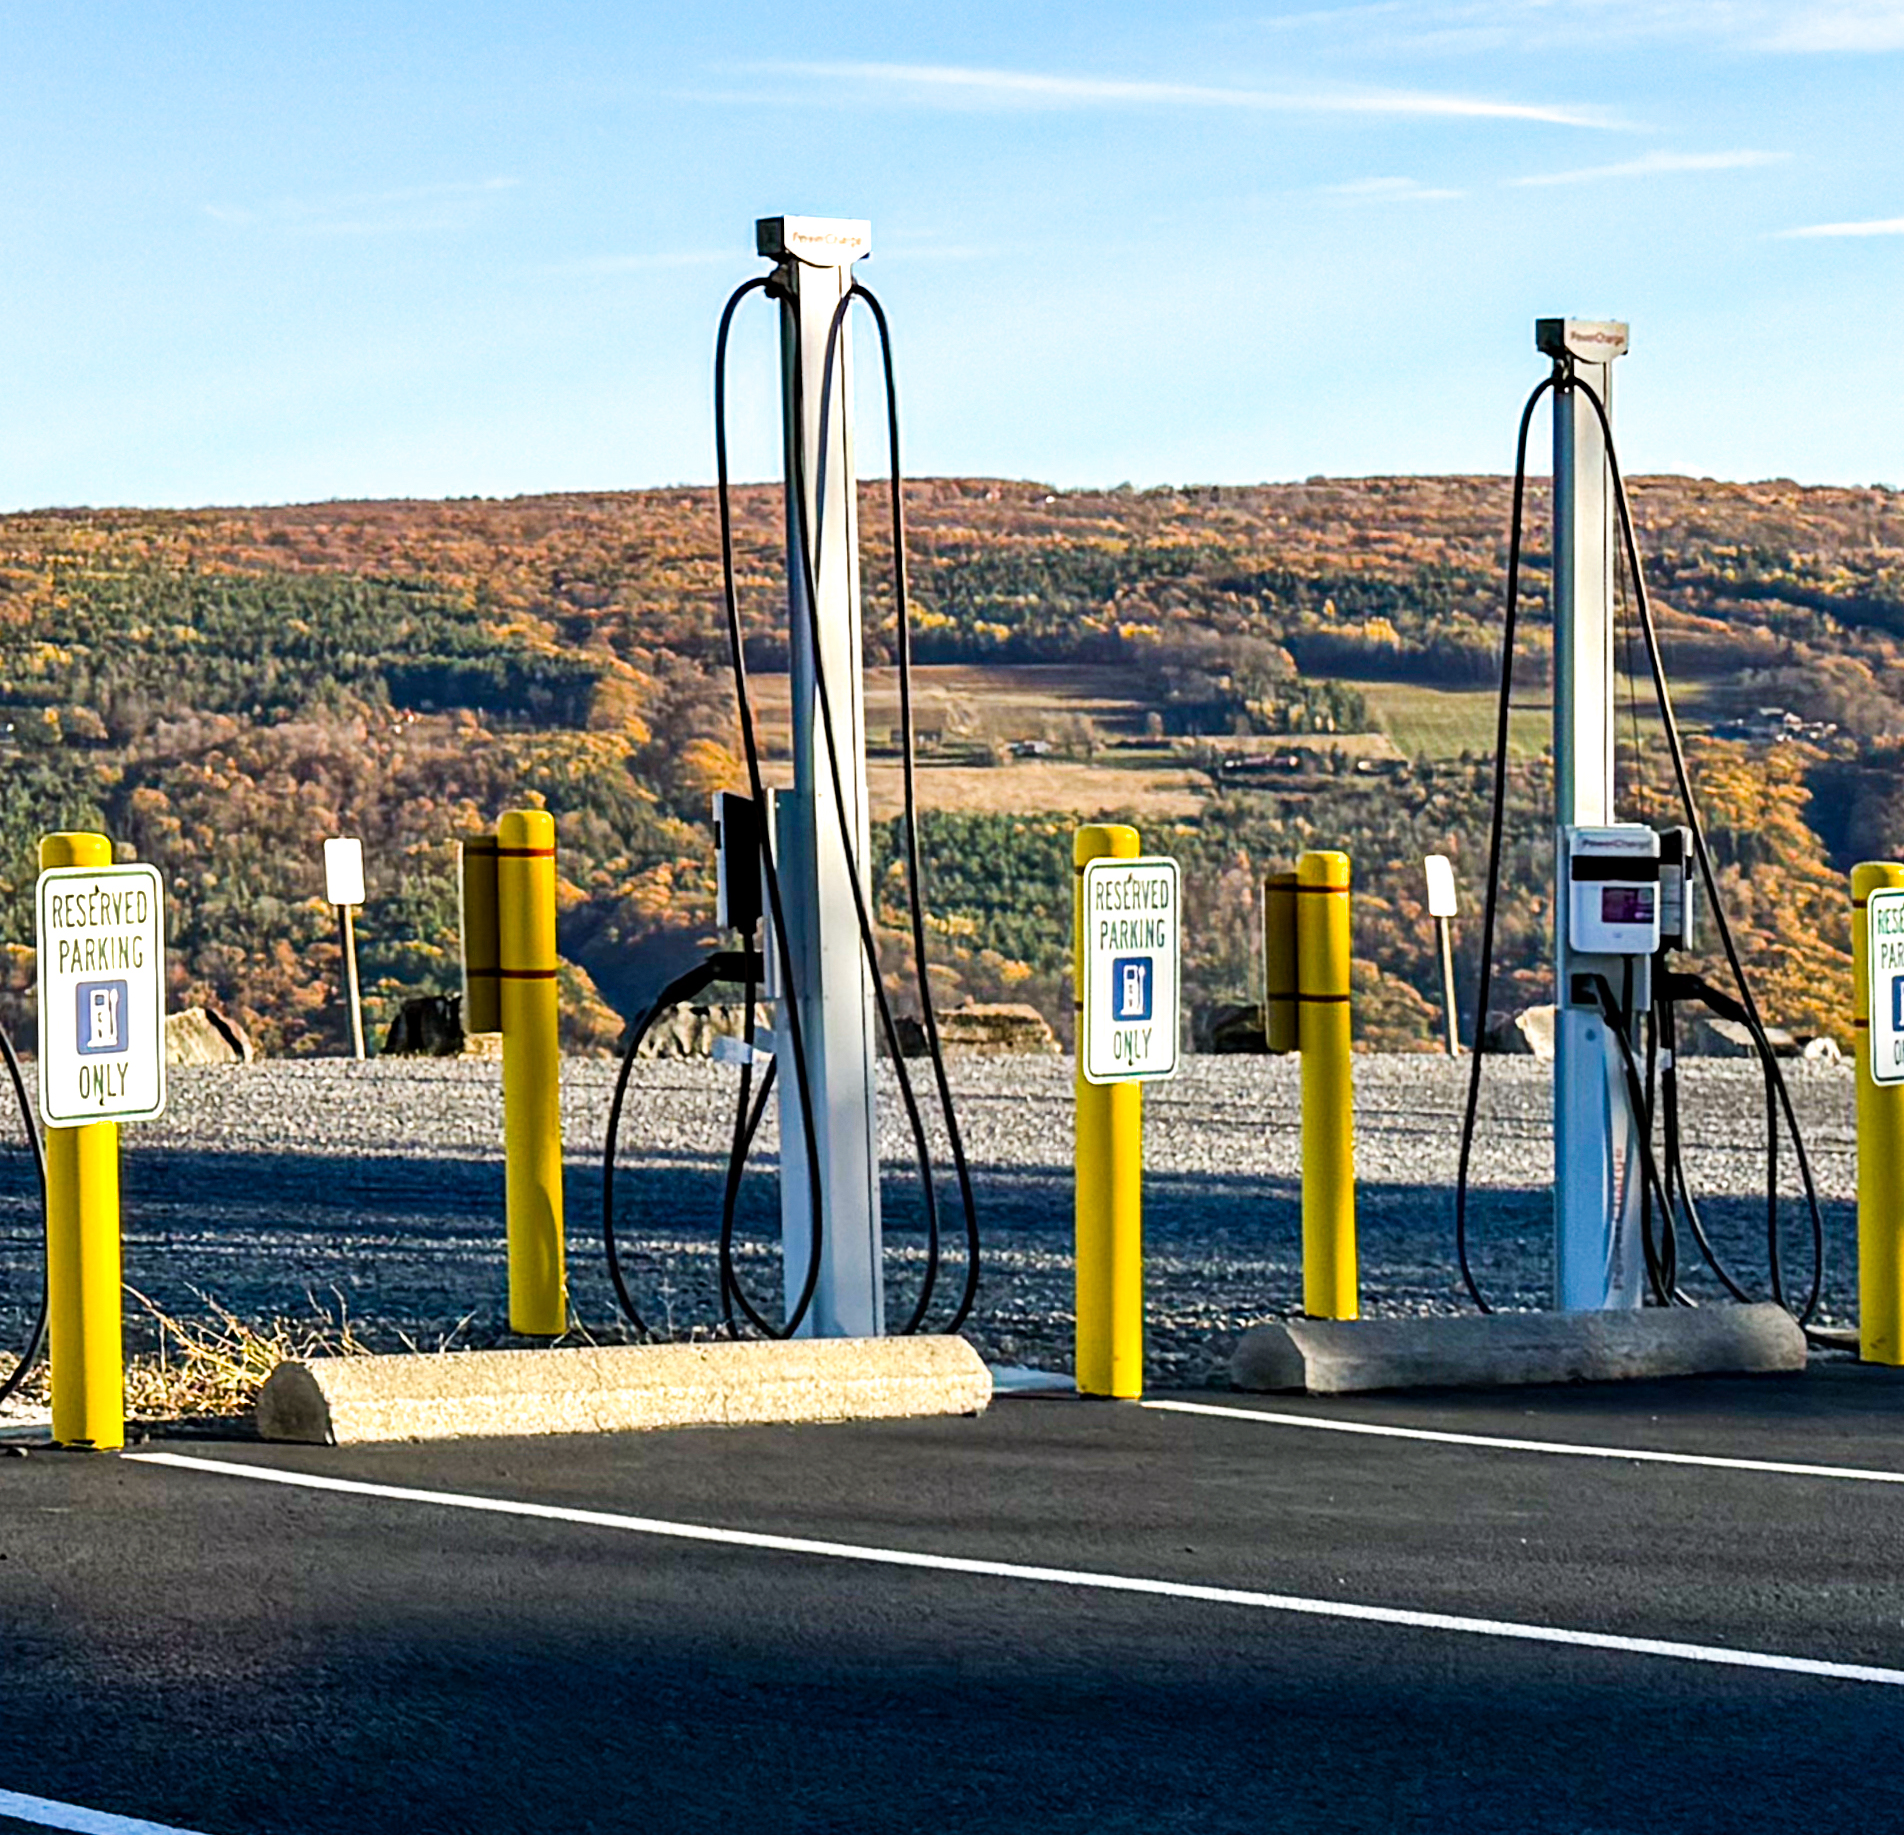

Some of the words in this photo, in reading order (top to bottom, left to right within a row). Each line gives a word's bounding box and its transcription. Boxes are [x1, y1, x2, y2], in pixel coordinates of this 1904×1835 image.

[52, 890, 148, 929] RESERVED
[1096, 878, 1169, 911] RESERVED
[1100, 917, 1166, 950] PARKING
[59, 935, 143, 974] PARKING
[1113, 1027, 1153, 1059] ONLY
[79, 1062, 129, 1099] ONLY
